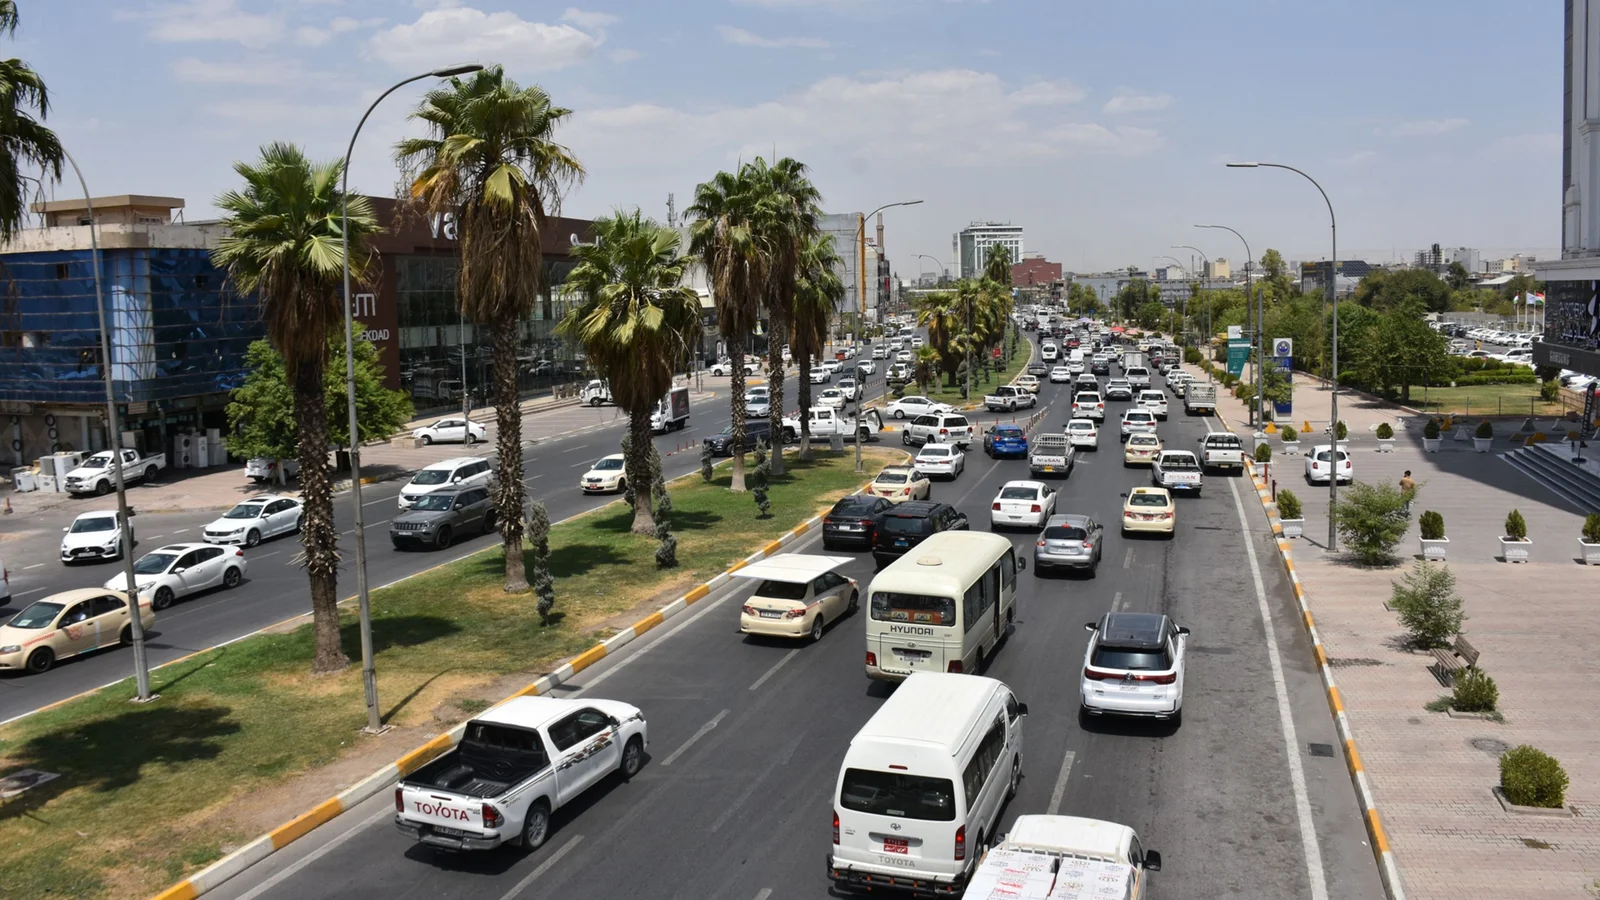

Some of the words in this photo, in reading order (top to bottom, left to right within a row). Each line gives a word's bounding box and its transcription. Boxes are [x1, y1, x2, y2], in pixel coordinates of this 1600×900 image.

[890, 625, 934, 636] HYUNDAI
[414, 801, 470, 821] TOYOTA
[878, 855, 916, 868] TOYOTA
